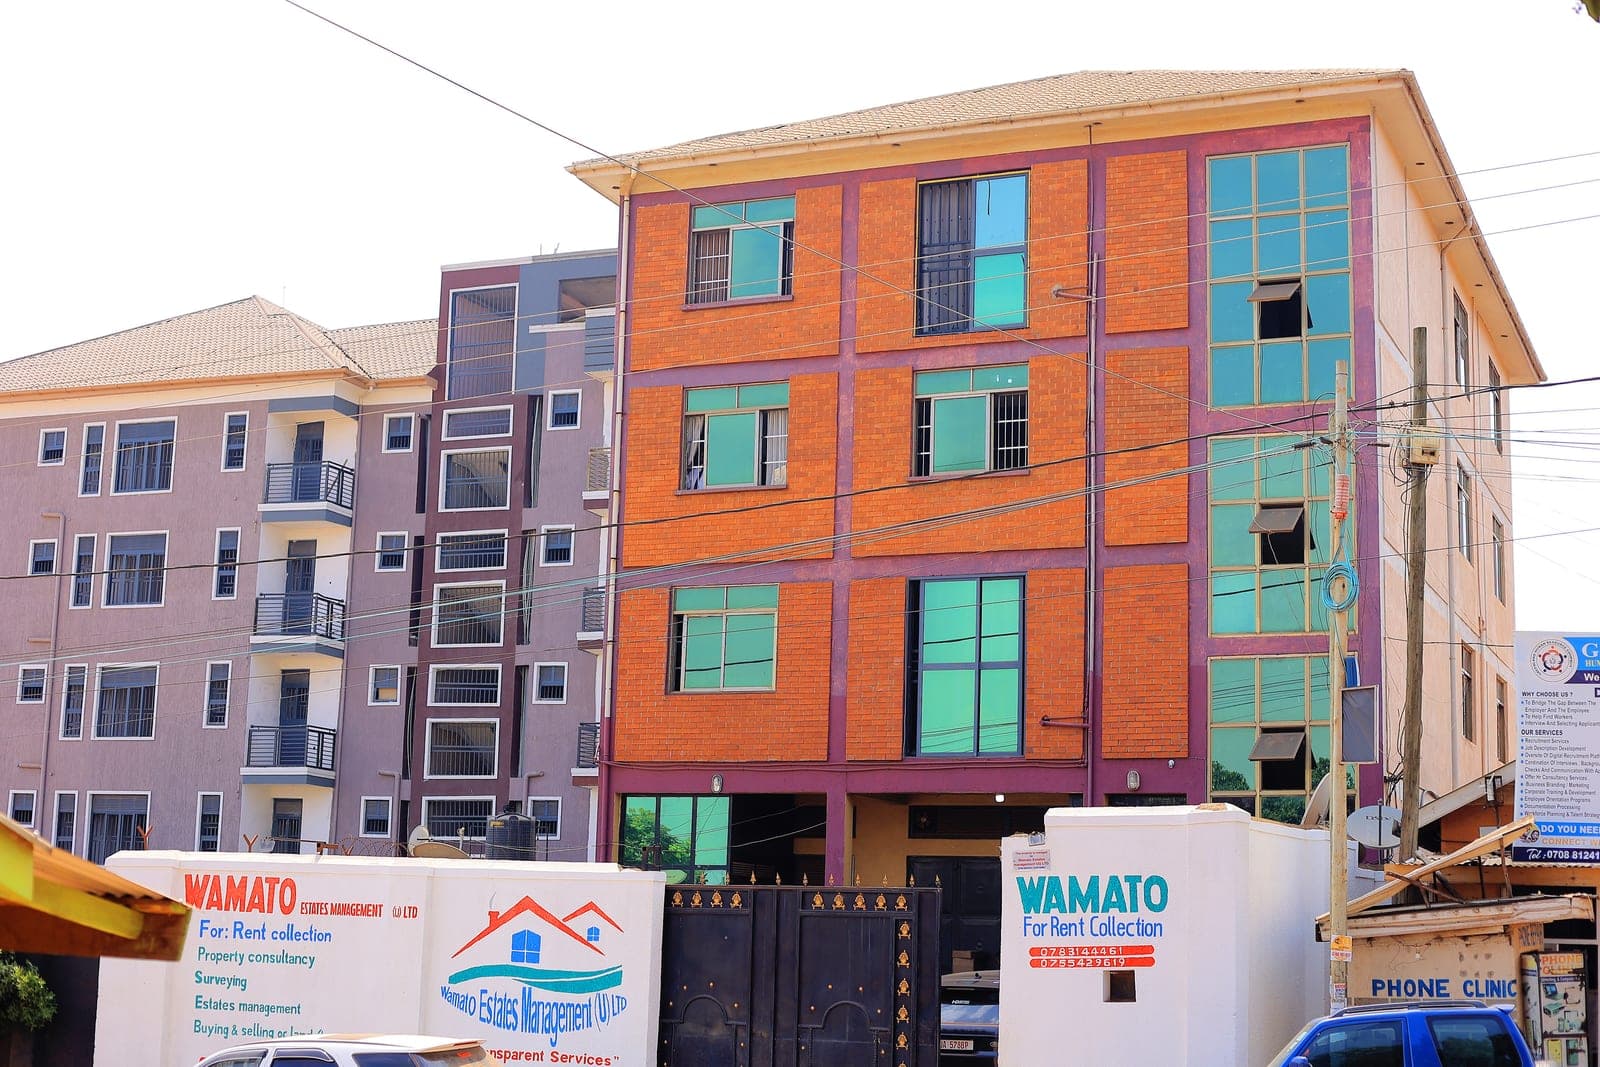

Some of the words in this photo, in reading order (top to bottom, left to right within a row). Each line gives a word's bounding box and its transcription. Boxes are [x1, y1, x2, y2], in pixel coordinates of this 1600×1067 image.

[1541, 824, 1554, 832] DO
[1557, 825, 1577, 833] YOU
[1580, 826, 1600, 834] NEE
[1546, 850, 1570, 859] 0708
[185, 874, 297, 915] WAMATO
[300, 902, 329, 915] ESTATES
[330, 902, 384, 918] MANAGEMENT
[403, 906, 418, 918] LTD
[1016, 875, 1168, 914] WAMATO
[200, 920, 229, 938] For:
[232, 921, 266, 940] Rent
[271, 923, 332, 942] collection
[1023, 916, 1048, 937] For
[1050, 916, 1084, 937] Rent
[1090, 915, 1162, 937] Collection
[198, 946, 244, 966] Property
[248, 949, 316, 969] consultancy
[194, 970, 248, 992] Surveying
[1372, 978, 1450, 998] PHONE
[1462, 979, 1518, 998] CLINIC
[195, 994, 235, 1012] Estates
[238, 1002, 302, 1017] management
[440, 985, 476, 1016] Wamato
[479, 988, 518, 1032] Estates
[521, 986, 592, 1048] Management
[612, 994, 627, 1017] LTD
[194, 1019, 229, 1040] Buying
[232, 1024, 238, 1036] &
[241, 1022, 275, 1039] selling
